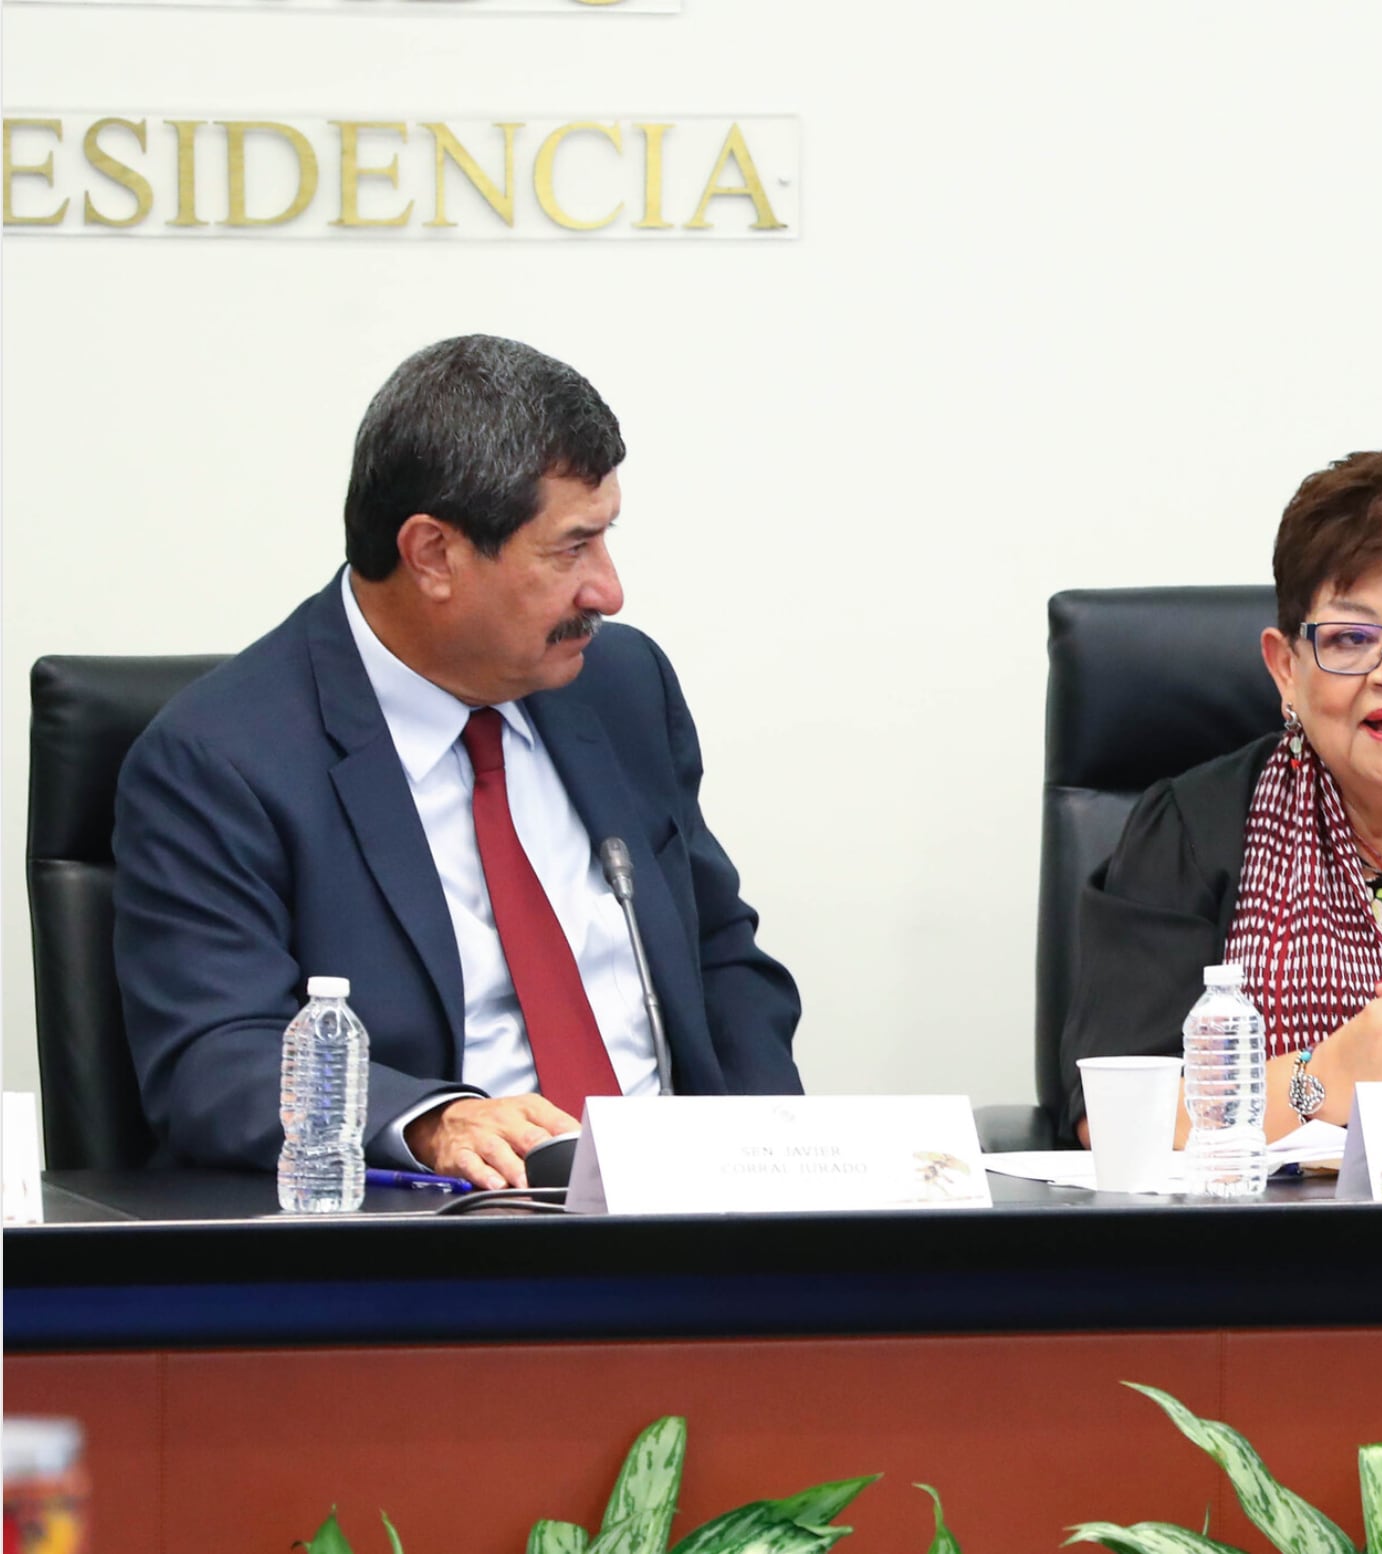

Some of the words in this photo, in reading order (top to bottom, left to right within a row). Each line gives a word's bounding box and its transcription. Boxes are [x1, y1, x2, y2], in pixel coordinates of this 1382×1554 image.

[3, 117, 787, 231] ESIDENCIA
[784, 1145, 841, 1158] JAVIER
[720, 1162, 791, 1175] CORRAL
